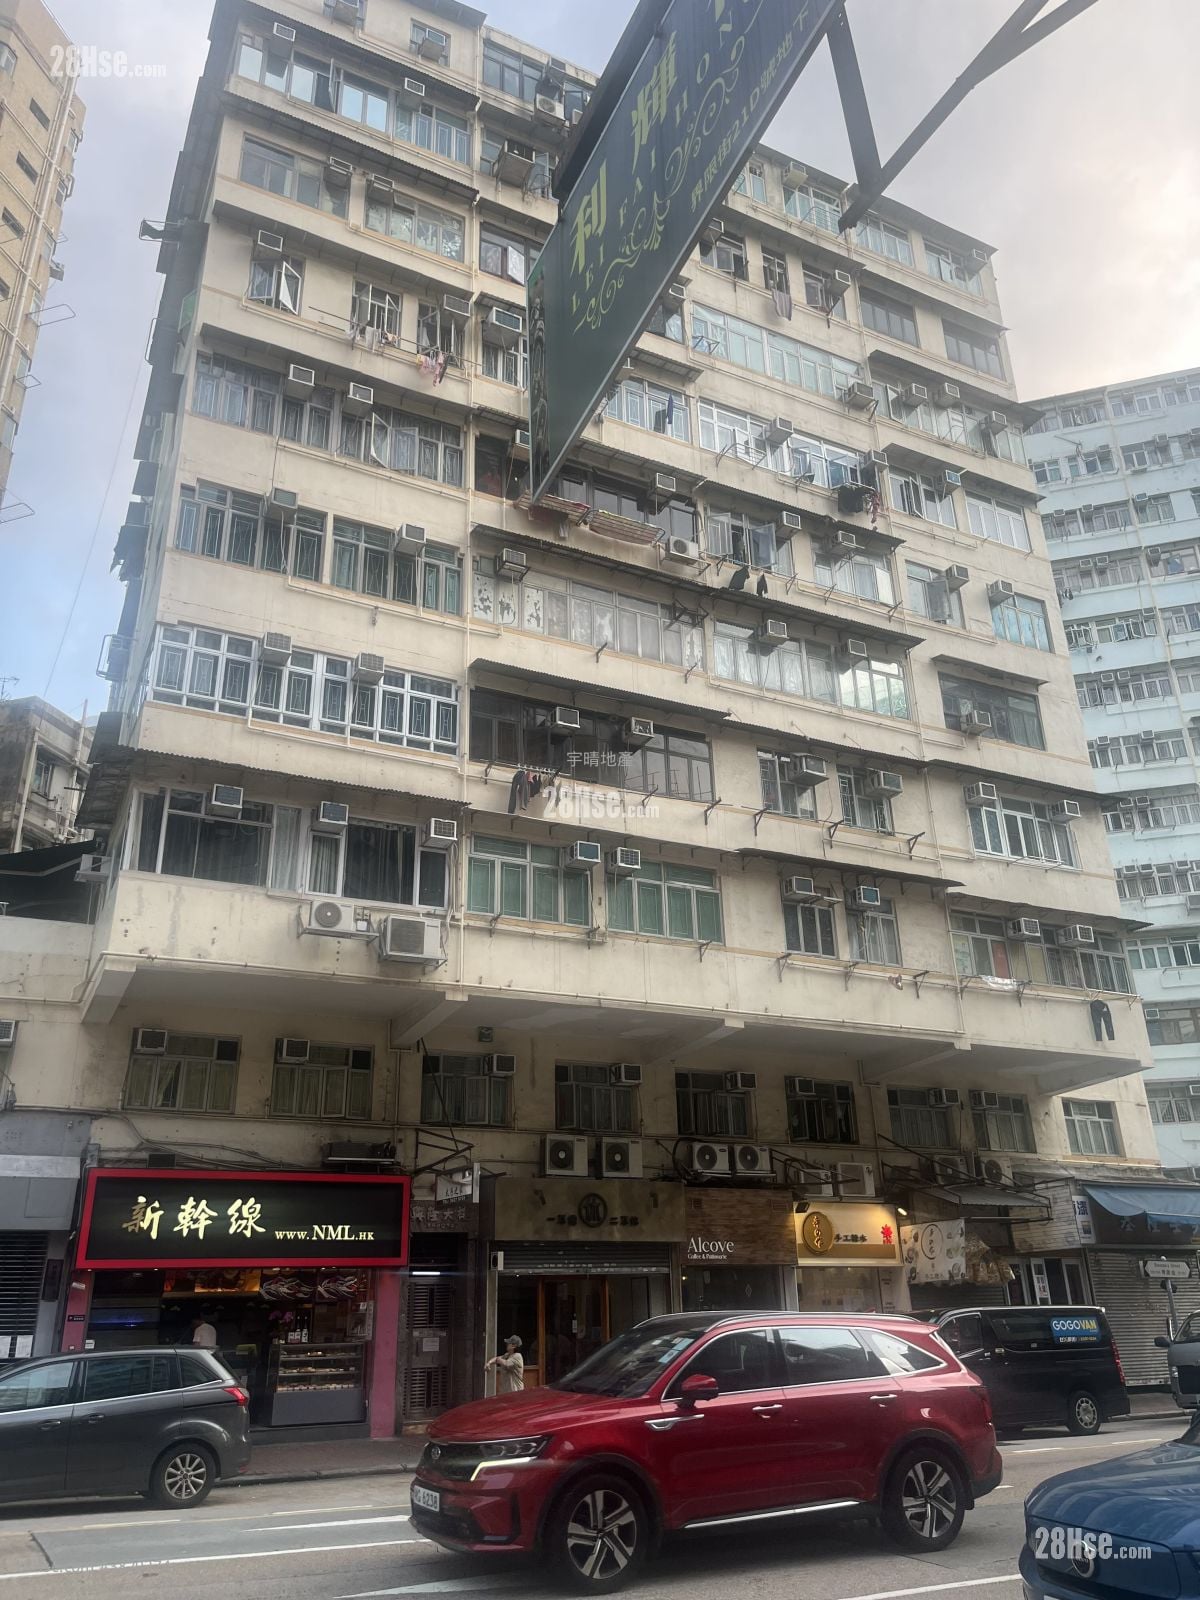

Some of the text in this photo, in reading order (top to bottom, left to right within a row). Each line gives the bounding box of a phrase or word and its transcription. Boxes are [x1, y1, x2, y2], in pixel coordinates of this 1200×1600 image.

[122, 1196, 266, 1240] 新幹線
[687, 1237, 734, 1253] Alcove
[1052, 1319, 1097, 1331] GOGOVAN
